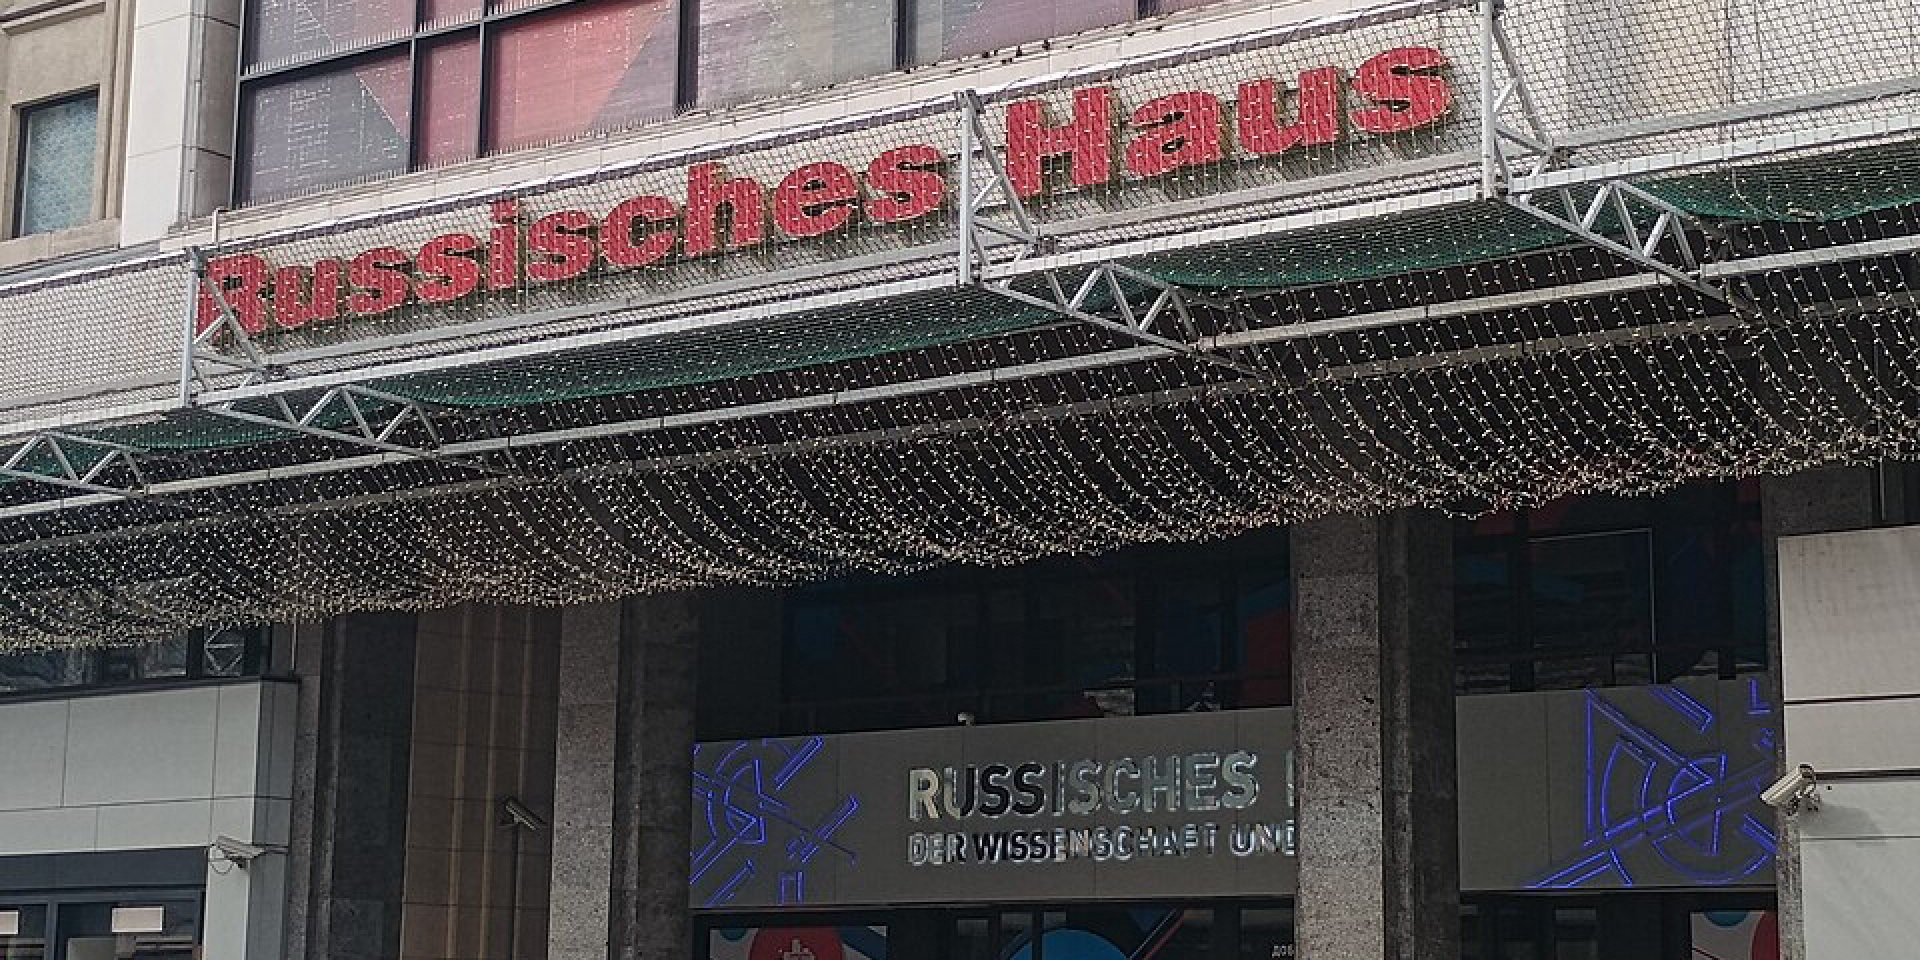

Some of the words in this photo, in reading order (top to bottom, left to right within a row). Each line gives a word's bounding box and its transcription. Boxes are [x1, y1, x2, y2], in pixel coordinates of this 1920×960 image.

[197, 144, 947, 337] Russisches
[1005, 46, 1453, 198] Haus
[908, 749, 1259, 821] RUSSISCHES
[907, 831, 967, 866] DER
[973, 822, 1219, 866] WISSENSCHAFT
